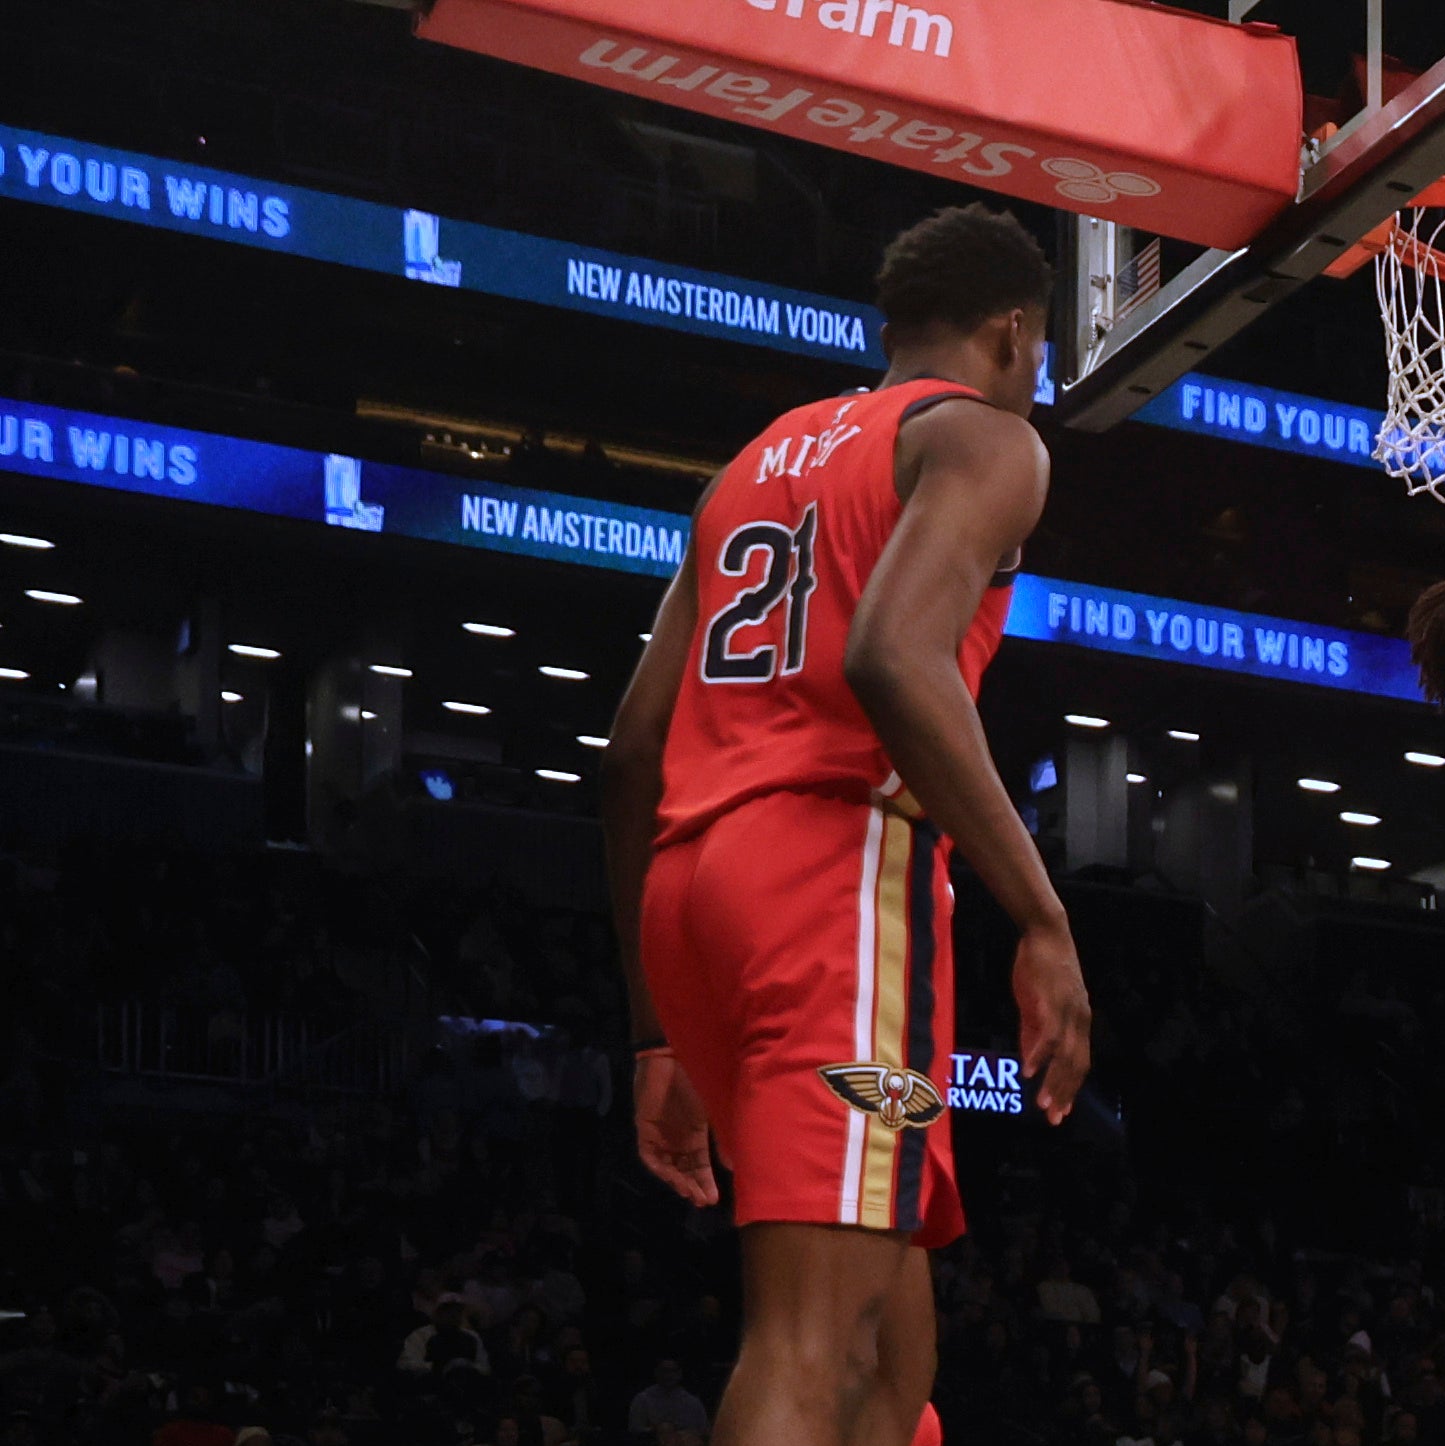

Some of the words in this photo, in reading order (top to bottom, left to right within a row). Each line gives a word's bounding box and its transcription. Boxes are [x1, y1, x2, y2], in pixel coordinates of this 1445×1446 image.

[17, 143, 151, 210] YOUR
[164, 174, 291, 239] WINS
[567, 258, 622, 302] NEW
[624, 271, 781, 336] AMSTERDAM
[786, 302, 867, 353] VODKA
[68, 425, 199, 486] WINS
[1181, 382, 1267, 434] FIND
[1275, 401, 1370, 456] YOUR
[461, 492, 519, 538] NEW
[521, 504, 682, 565] AMSTERDAM
[700, 500, 819, 684] 21
[1048, 592, 1137, 641] FIND
[1145, 608, 1246, 660] YOUR
[1253, 627, 1349, 677] WINS
[946, 1053, 1022, 1091] TAR
